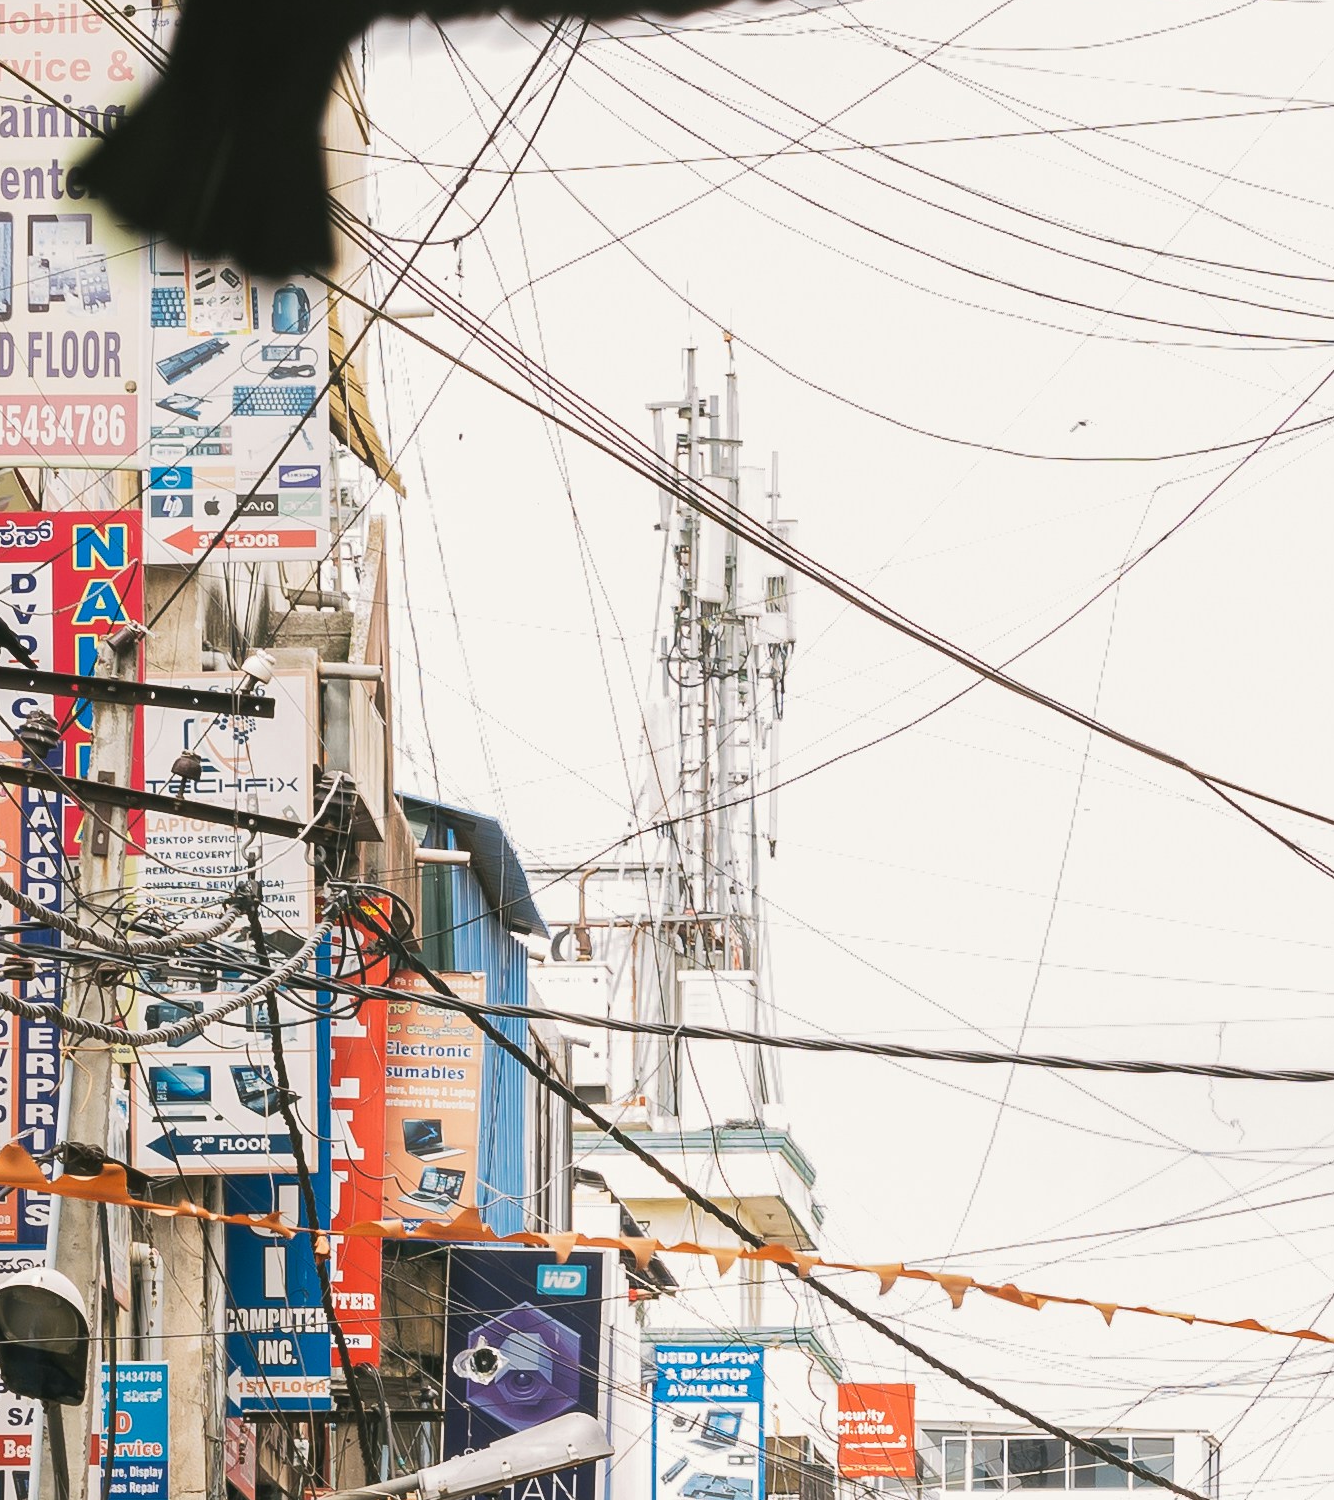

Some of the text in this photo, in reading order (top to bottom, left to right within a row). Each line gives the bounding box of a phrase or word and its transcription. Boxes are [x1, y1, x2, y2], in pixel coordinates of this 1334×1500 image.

[27, 330, 121, 379] FLOOR
[226, 1308, 328, 1333] COMPUTER
[258, 1340, 297, 1365] INC.
[657, 1352, 759, 1365] USED LAPTOP
[272, 1381, 326, 1393] FLOOR
[667, 1385, 747, 1397] AVAILABLE
